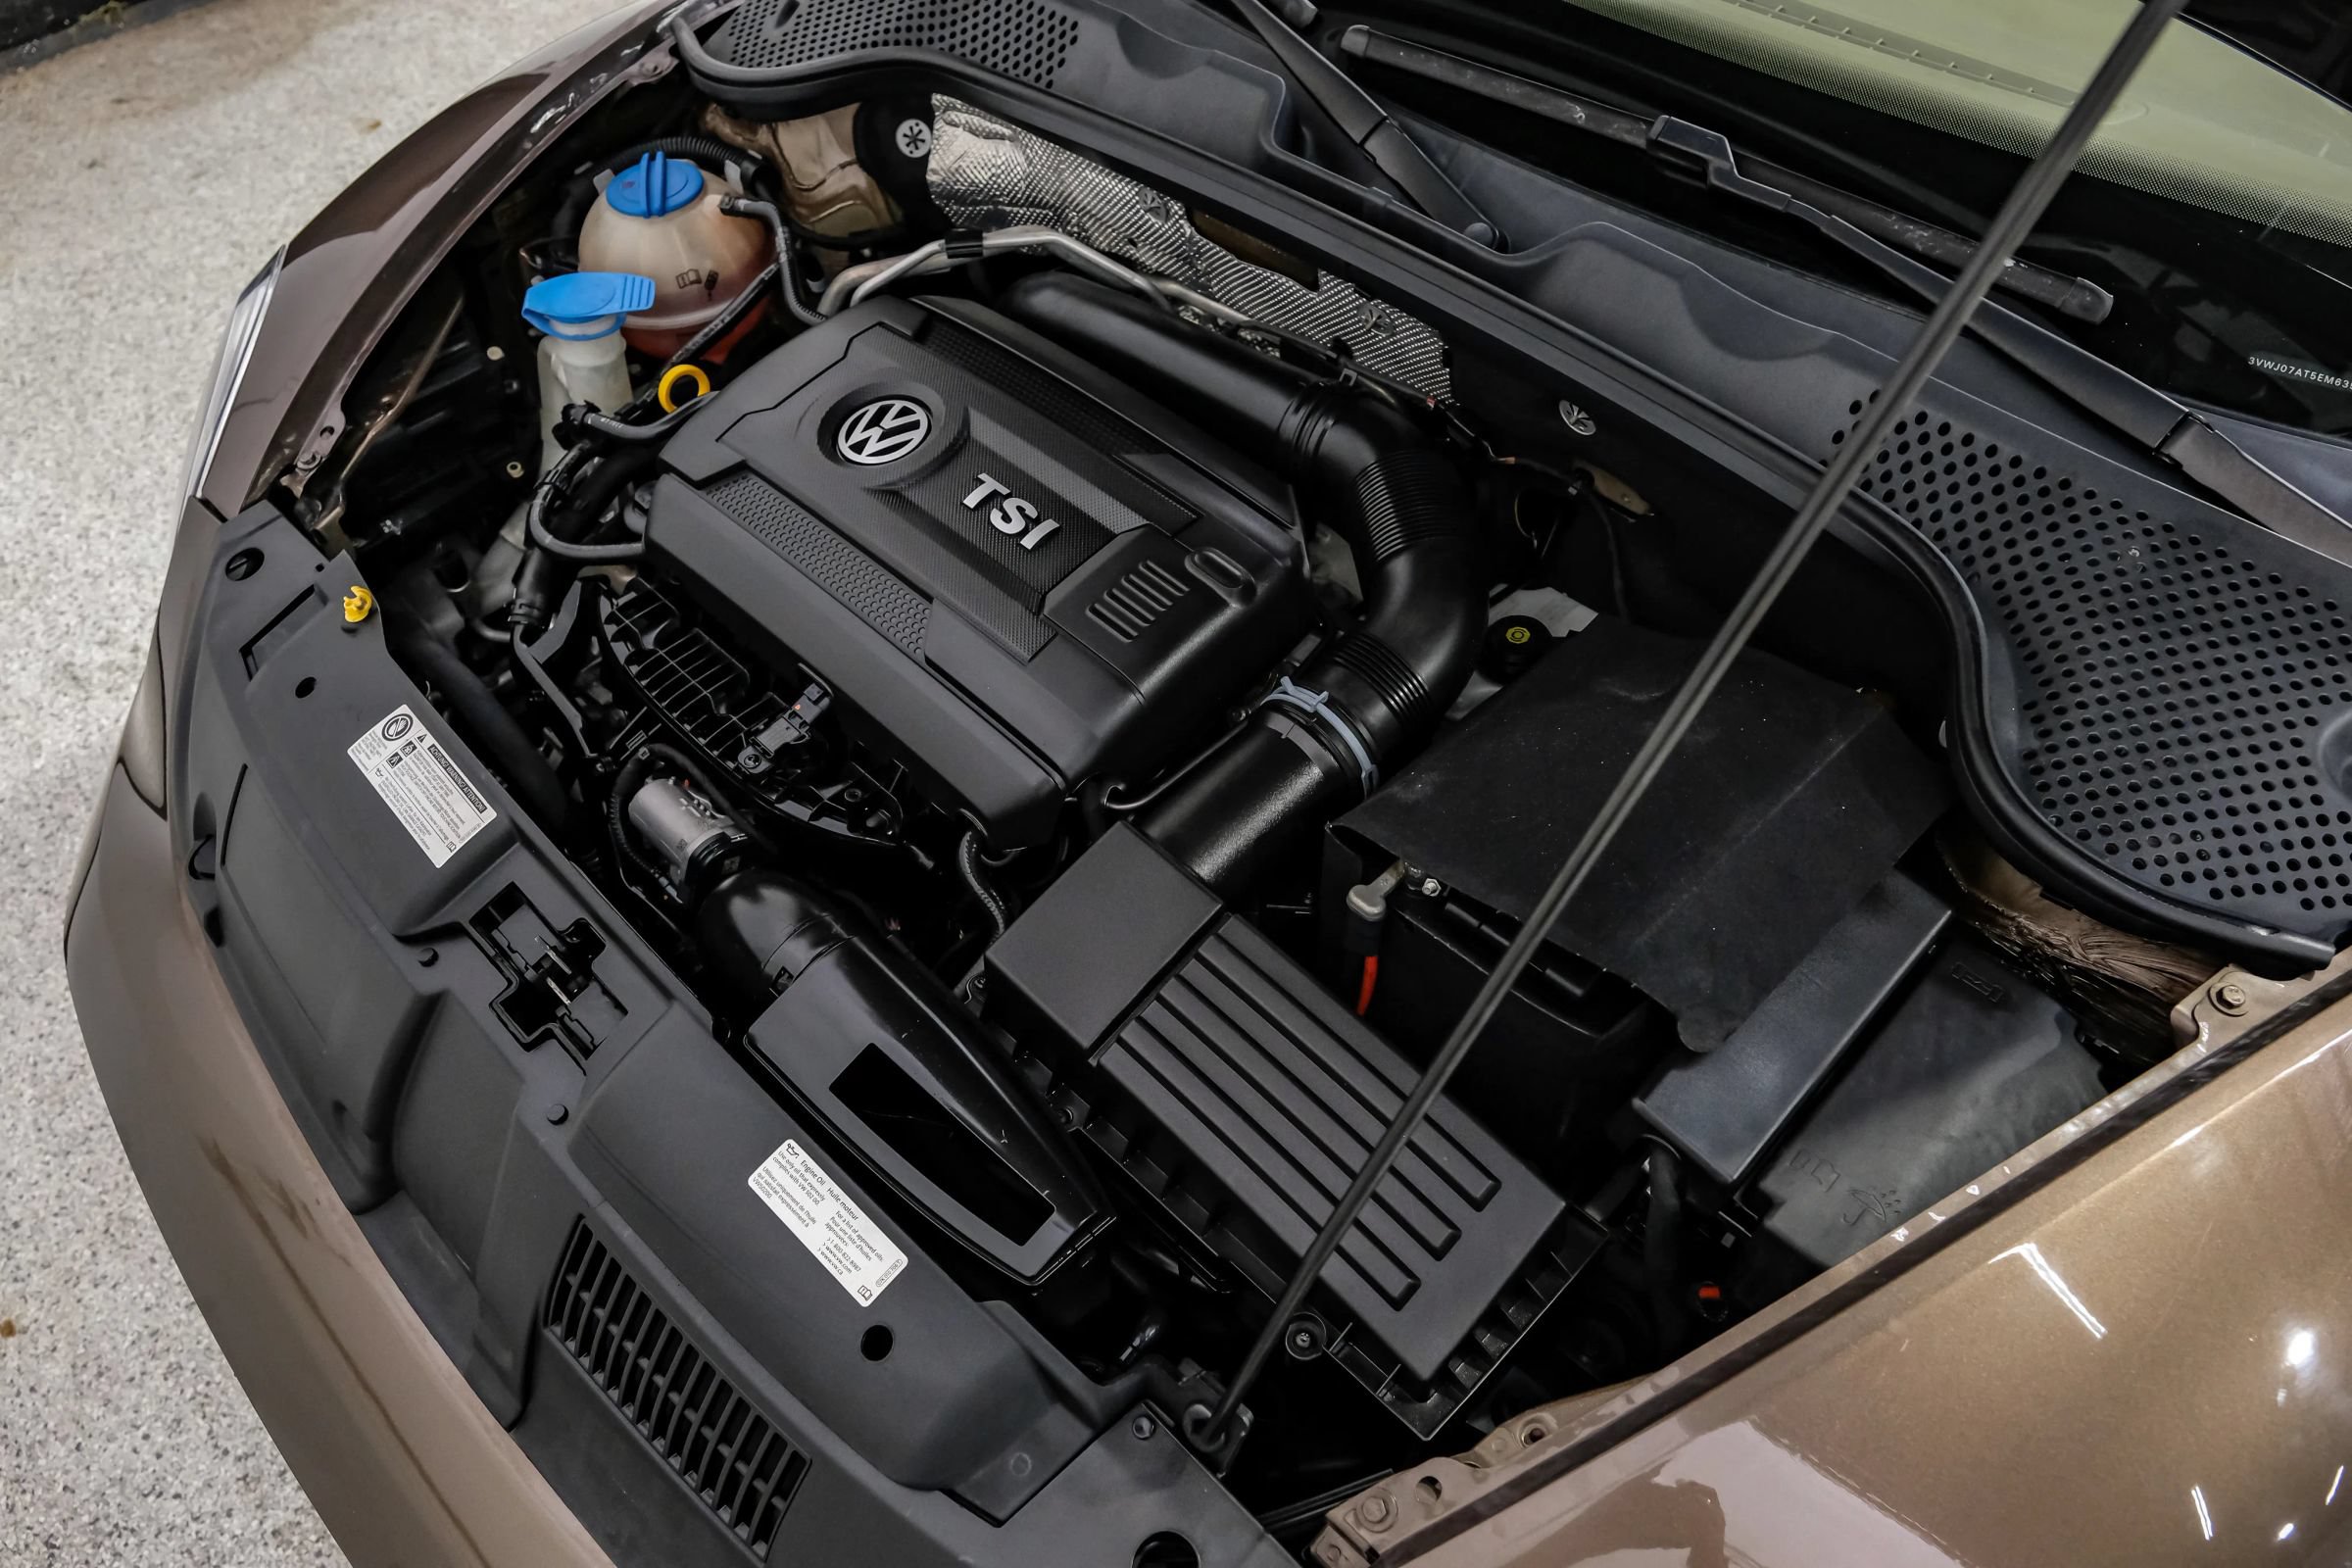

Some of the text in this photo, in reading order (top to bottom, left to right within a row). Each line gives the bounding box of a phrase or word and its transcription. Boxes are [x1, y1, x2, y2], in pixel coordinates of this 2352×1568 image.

[962, 472, 1060, 551] TSI
[429, 747, 449, 767] ACHTUNG!
[446, 766, 466, 788] WARNING!
[463, 787, 485, 811] ATTENTION!
[763, 1179, 779, 1196] satisfait
[773, 1157, 790, 1174] complies
[789, 1174, 799, 1184] with
[798, 1182, 807, 1191] VW
[786, 1159, 795, 1169] only
[799, 1172, 808, 1183] that
[807, 1182, 825, 1201] expressly
[801, 1160, 826, 1186] Engine Oil
[762, 1166, 777, 1183] Utilisez
[776, 1182, 800, 1206] uniquement
[804, 1210, 816, 1224] l'huile
[827, 1187, 858, 1220] Huile moteur
[830, 1216, 871, 1261] Pour une liste d'huiles
[857, 1234, 876, 1253] approved
